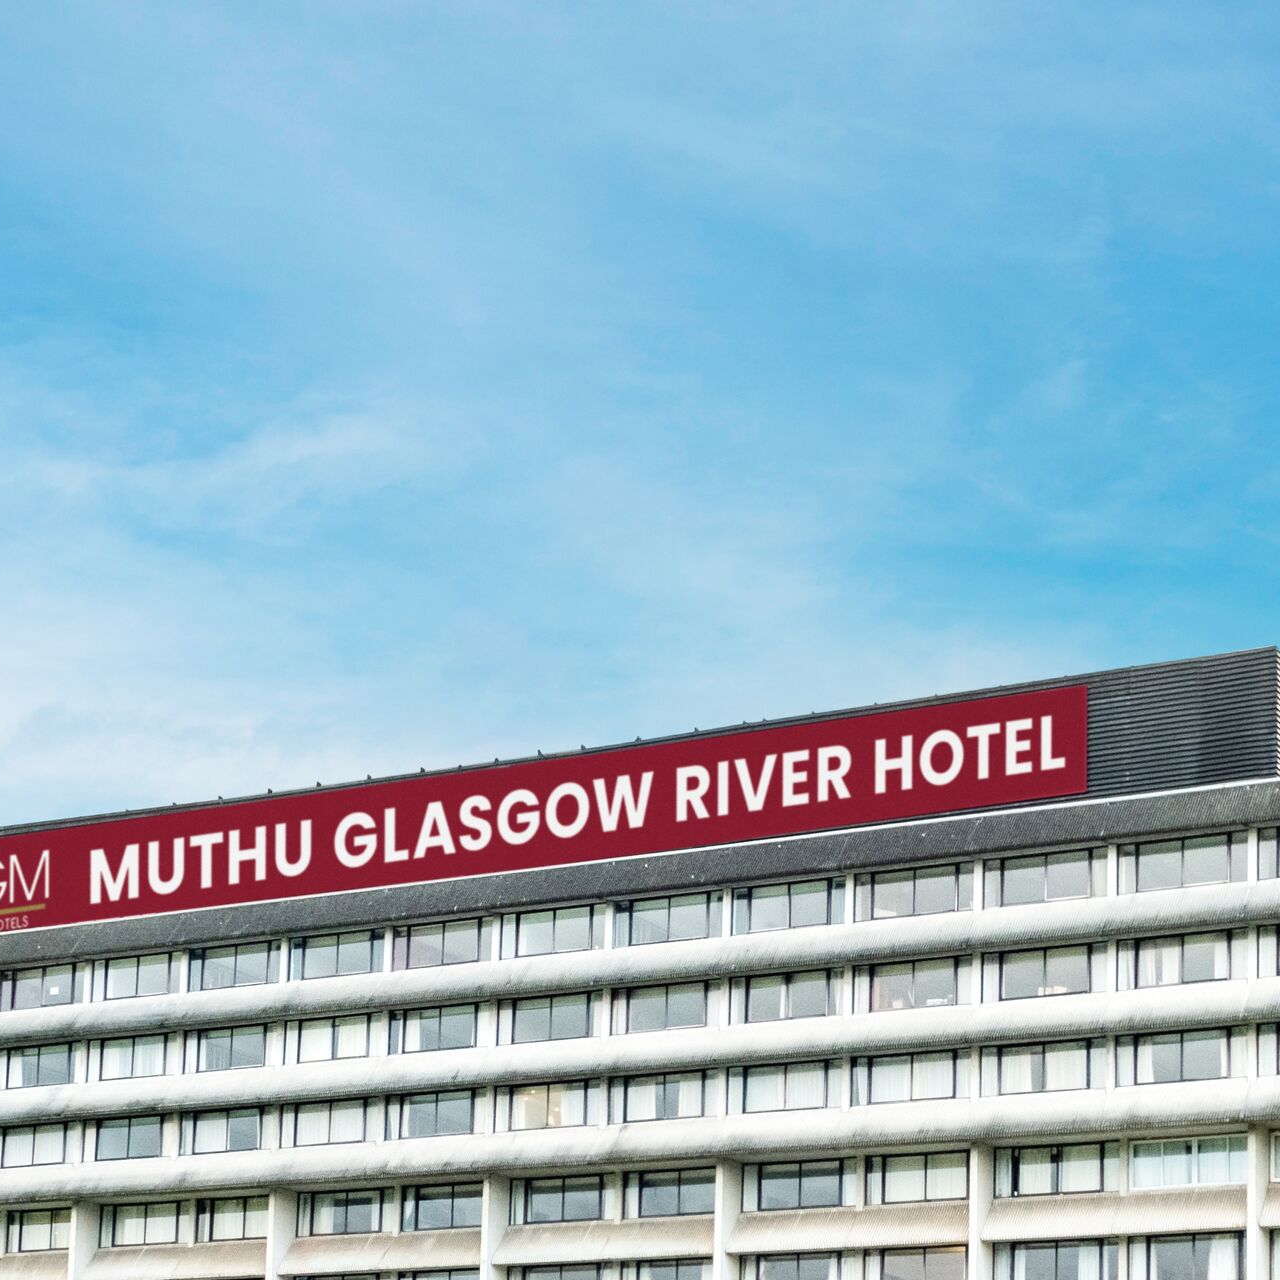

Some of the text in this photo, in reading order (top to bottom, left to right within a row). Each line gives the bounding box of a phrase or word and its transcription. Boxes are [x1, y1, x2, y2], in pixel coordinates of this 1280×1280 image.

[89, 715, 1066, 905] MUTHU GLASGOW RIVER HOTEL
